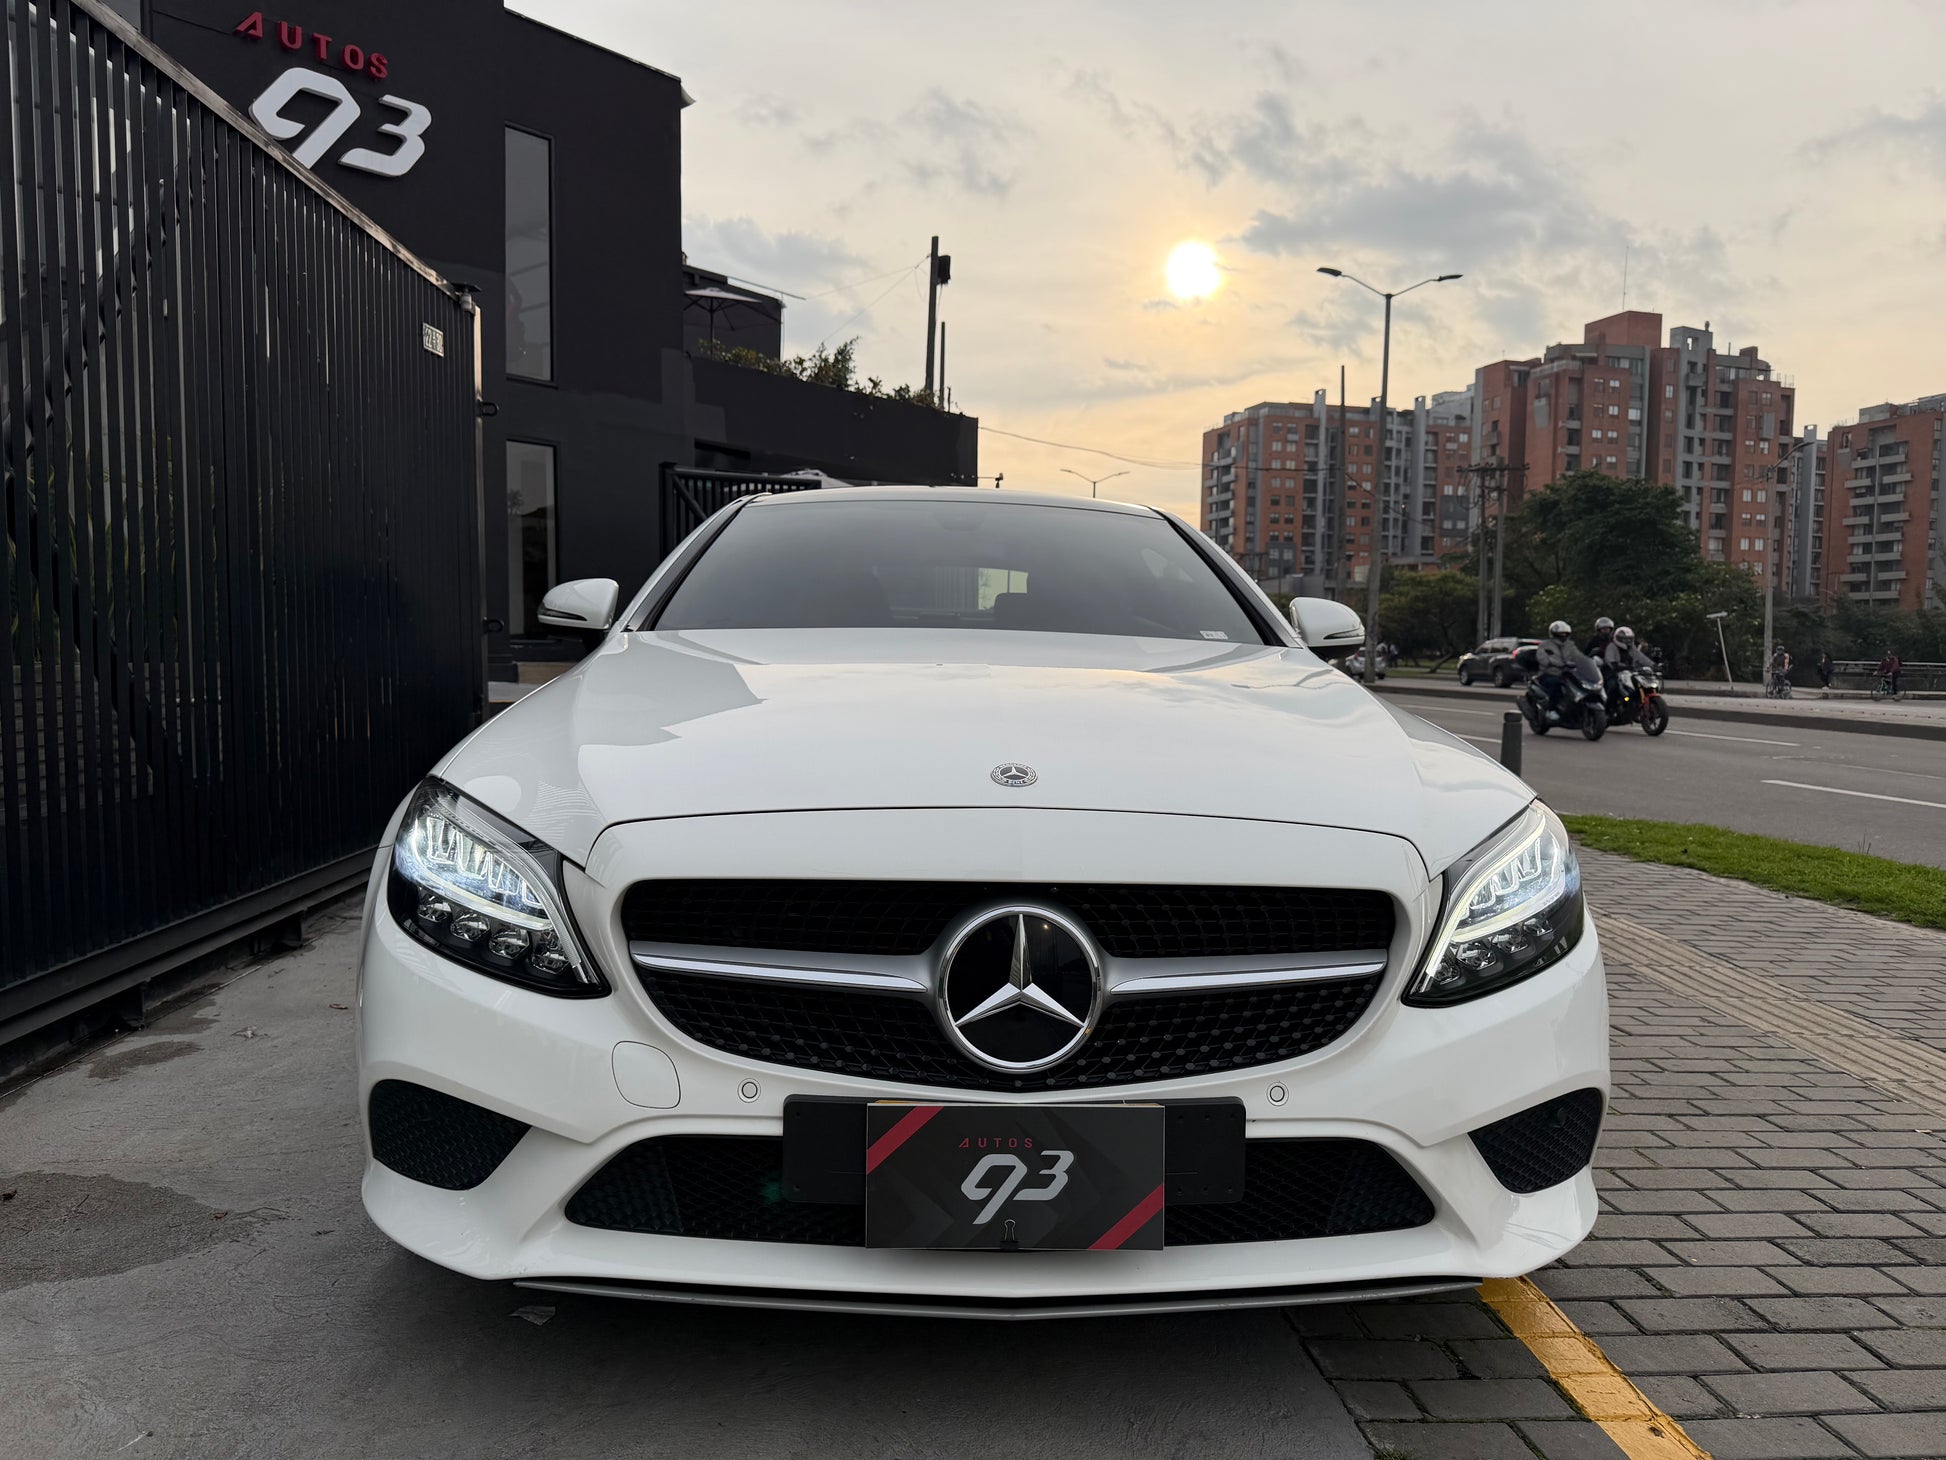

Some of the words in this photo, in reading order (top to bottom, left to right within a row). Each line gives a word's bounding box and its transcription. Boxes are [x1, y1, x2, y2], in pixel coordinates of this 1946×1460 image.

[233, 11, 389, 80] AUTOS
[248, 67, 433, 178] 93
[959, 1137, 1034, 1149] AUTOS
[960, 1150, 1075, 1225] 93
